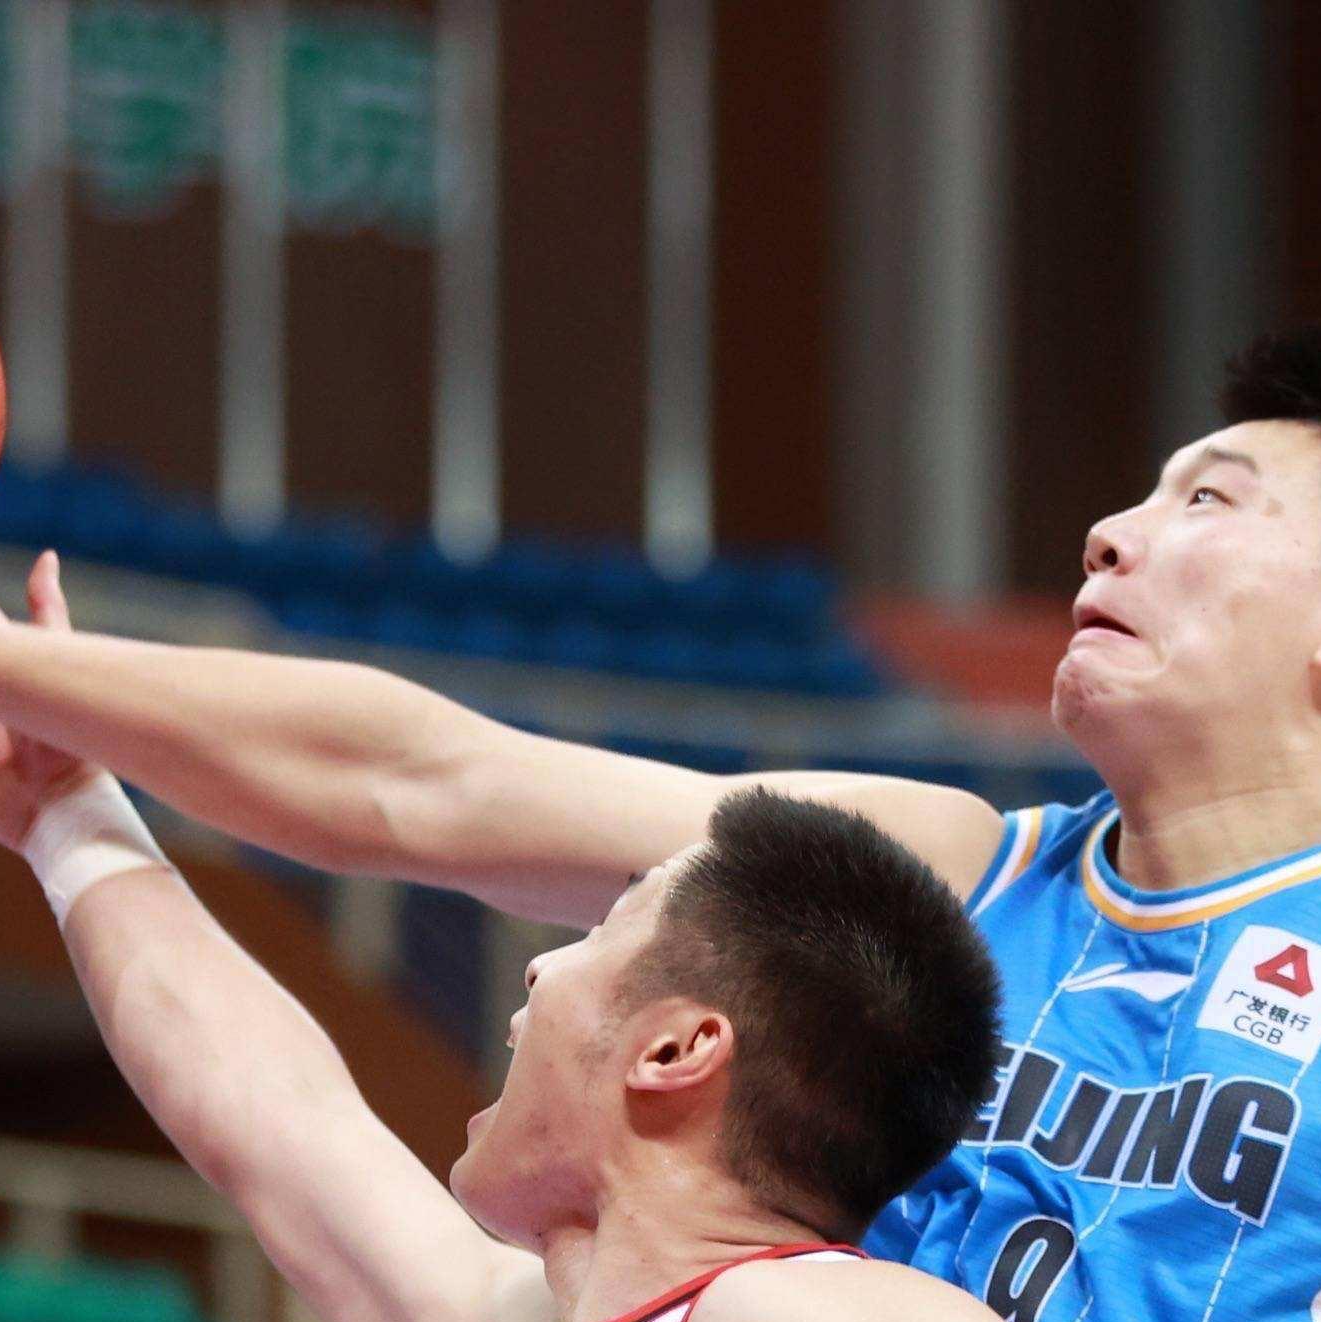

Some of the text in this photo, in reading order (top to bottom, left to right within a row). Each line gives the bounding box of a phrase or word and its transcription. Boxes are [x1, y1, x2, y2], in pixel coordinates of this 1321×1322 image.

[1223, 988, 1312, 1033] 广发银行
[1233, 1014, 1284, 1046] CGB
[958, 1041, 1302, 1228] EIJING
